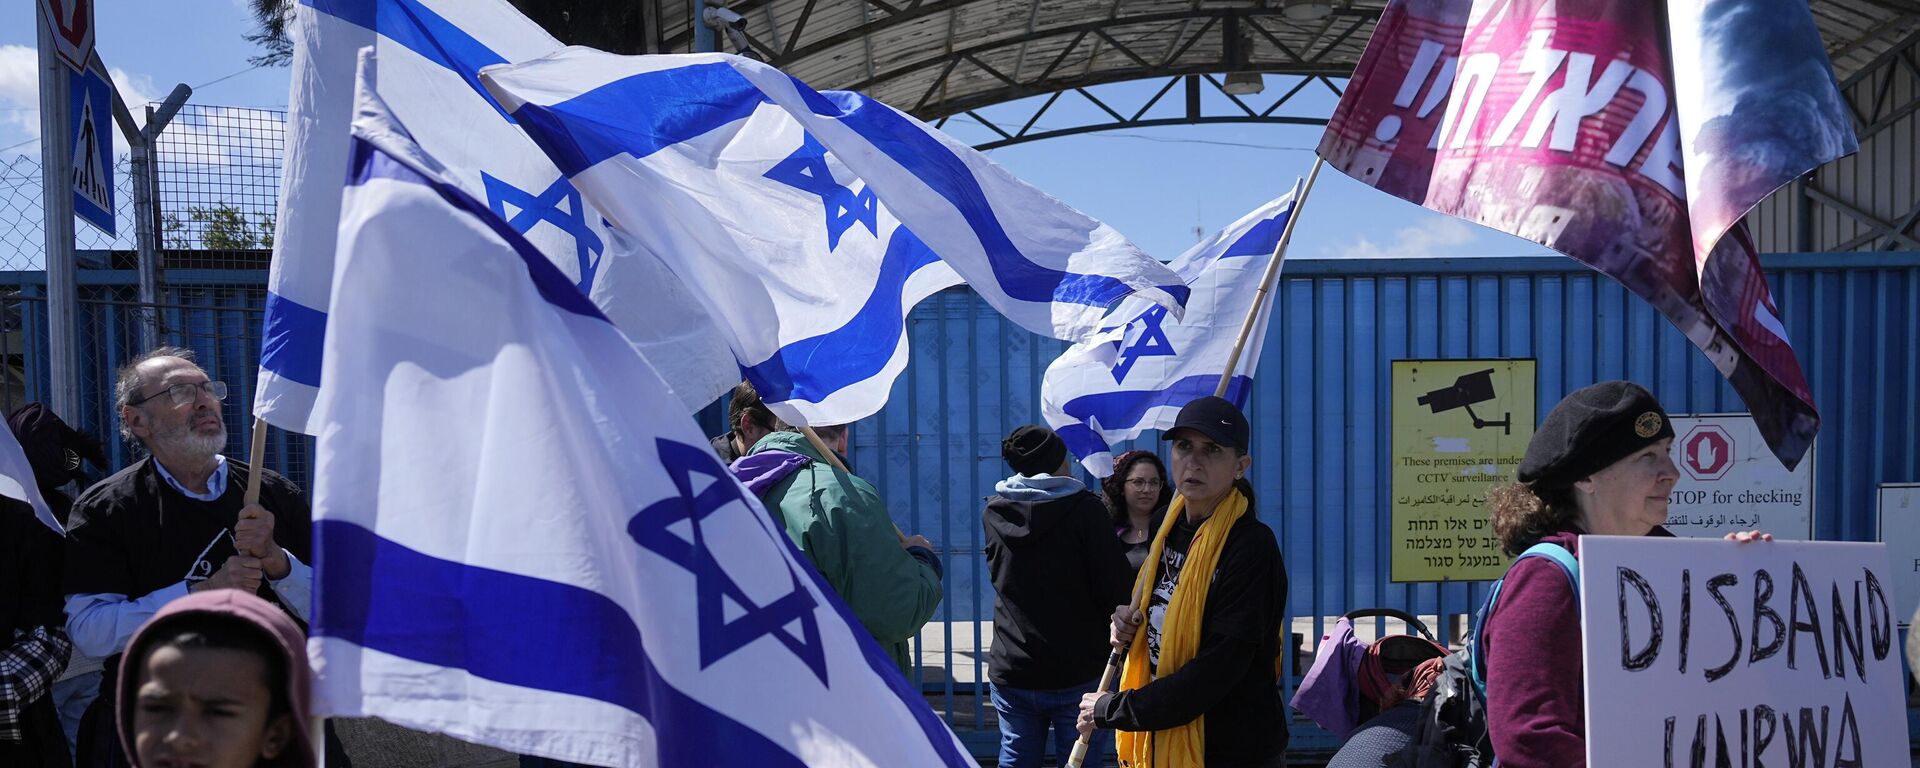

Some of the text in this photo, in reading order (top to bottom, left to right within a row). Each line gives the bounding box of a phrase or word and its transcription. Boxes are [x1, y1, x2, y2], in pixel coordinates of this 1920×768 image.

[1402, 456, 1431, 466] These
[1434, 455, 1476, 468] premises
[1497, 455, 1524, 465] under
[1417, 472, 1509, 483] CCTV surveillance
[1712, 490, 1733, 504] for
[1738, 489, 1802, 506] checking
[1407, 519, 1438, 530] תחת
[1444, 516, 1467, 530] אלו
[1690, 513, 1726, 528] الوقوف
[1729, 513, 1760, 528] الرجاء
[1406, 535, 1498, 550] קב של מצלמה
[1423, 552, 1500, 567] במעגל סגור
[1616, 561, 1892, 684] DISBAND
